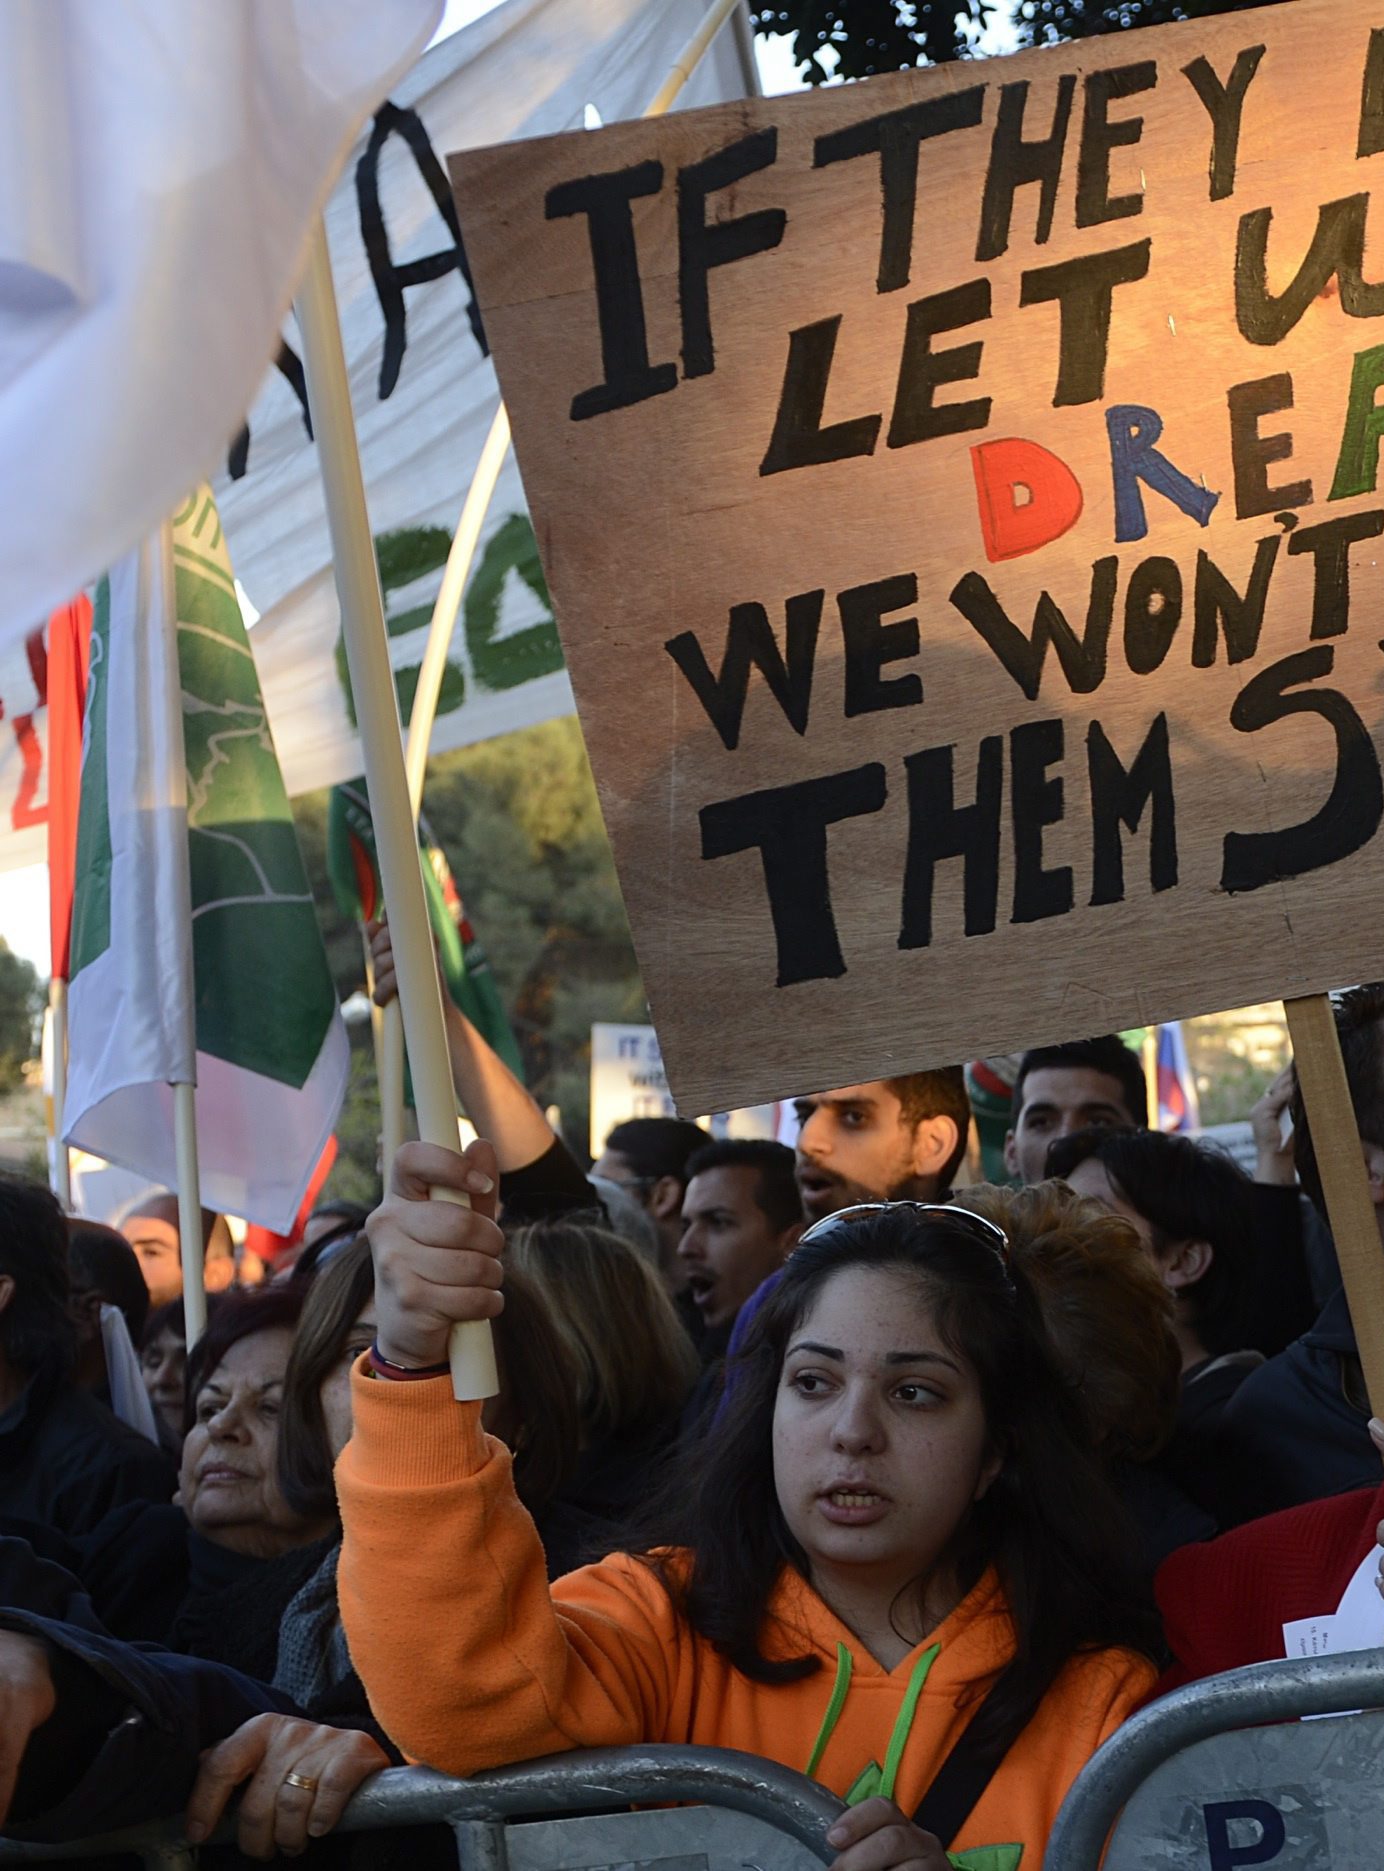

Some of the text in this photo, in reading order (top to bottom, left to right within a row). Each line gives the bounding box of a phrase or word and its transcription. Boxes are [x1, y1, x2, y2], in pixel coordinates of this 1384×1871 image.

[544, 126, 787, 421] IF
[811, 43, 1266, 294] THEY
[760, 238, 1151, 477] LET
[665, 572, 923, 751] WE
[699, 711, 1178, 988] THEM
